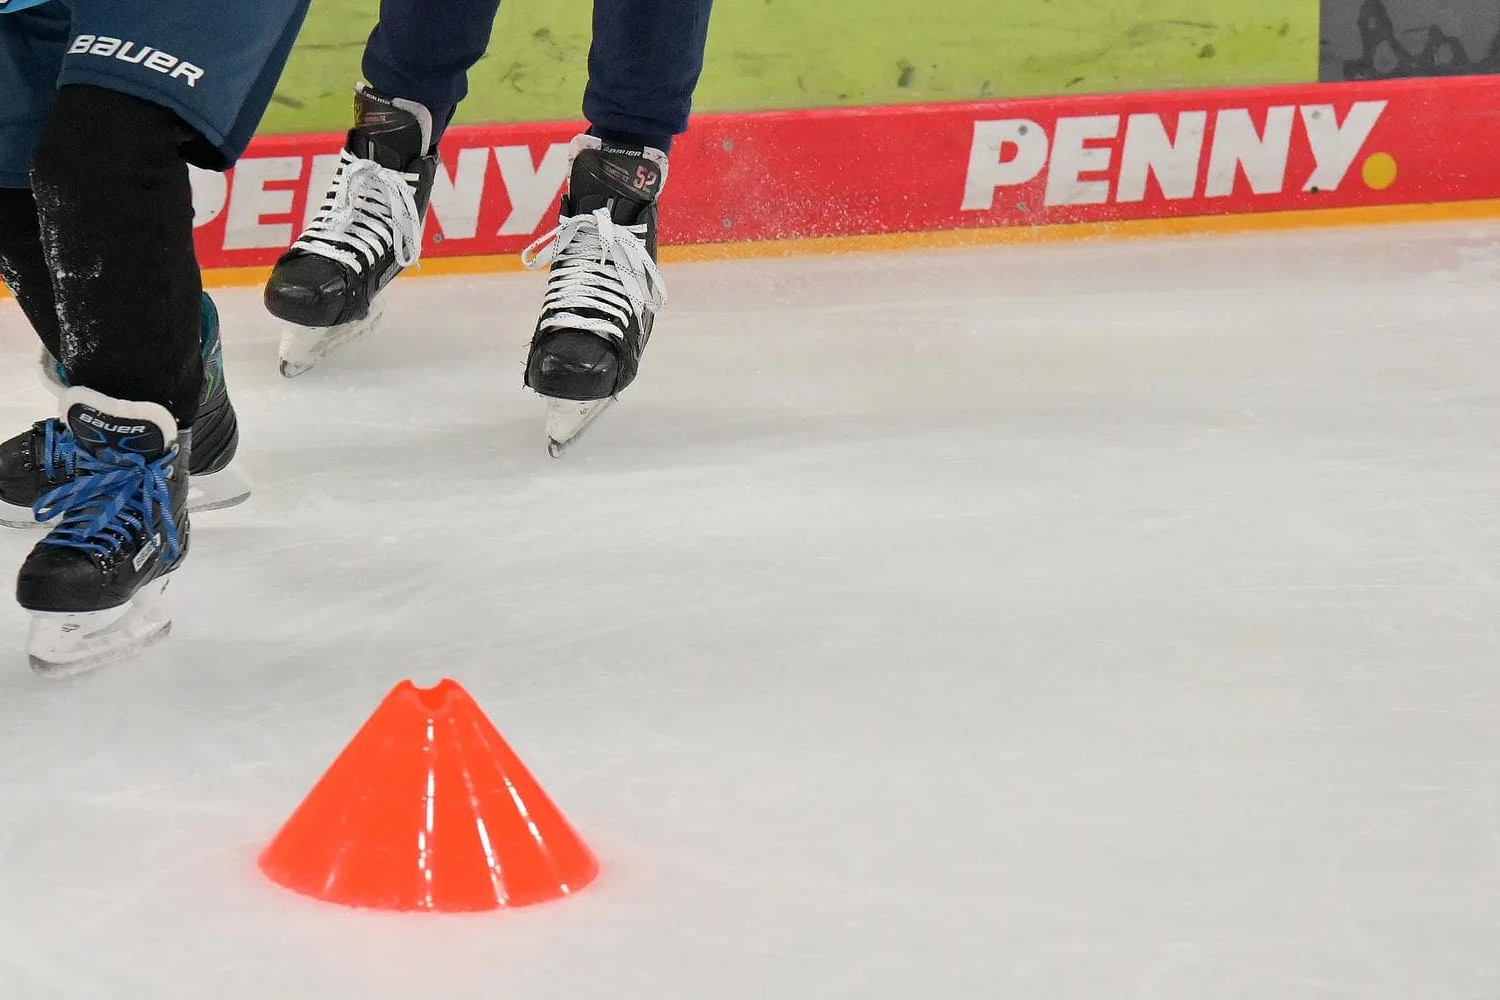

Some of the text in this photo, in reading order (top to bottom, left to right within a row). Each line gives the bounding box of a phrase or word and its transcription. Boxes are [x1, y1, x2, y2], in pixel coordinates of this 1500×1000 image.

[67, 34, 205, 87] BAUER
[633, 165, 657, 193] 52
[79, 413, 147, 434] BAUER
